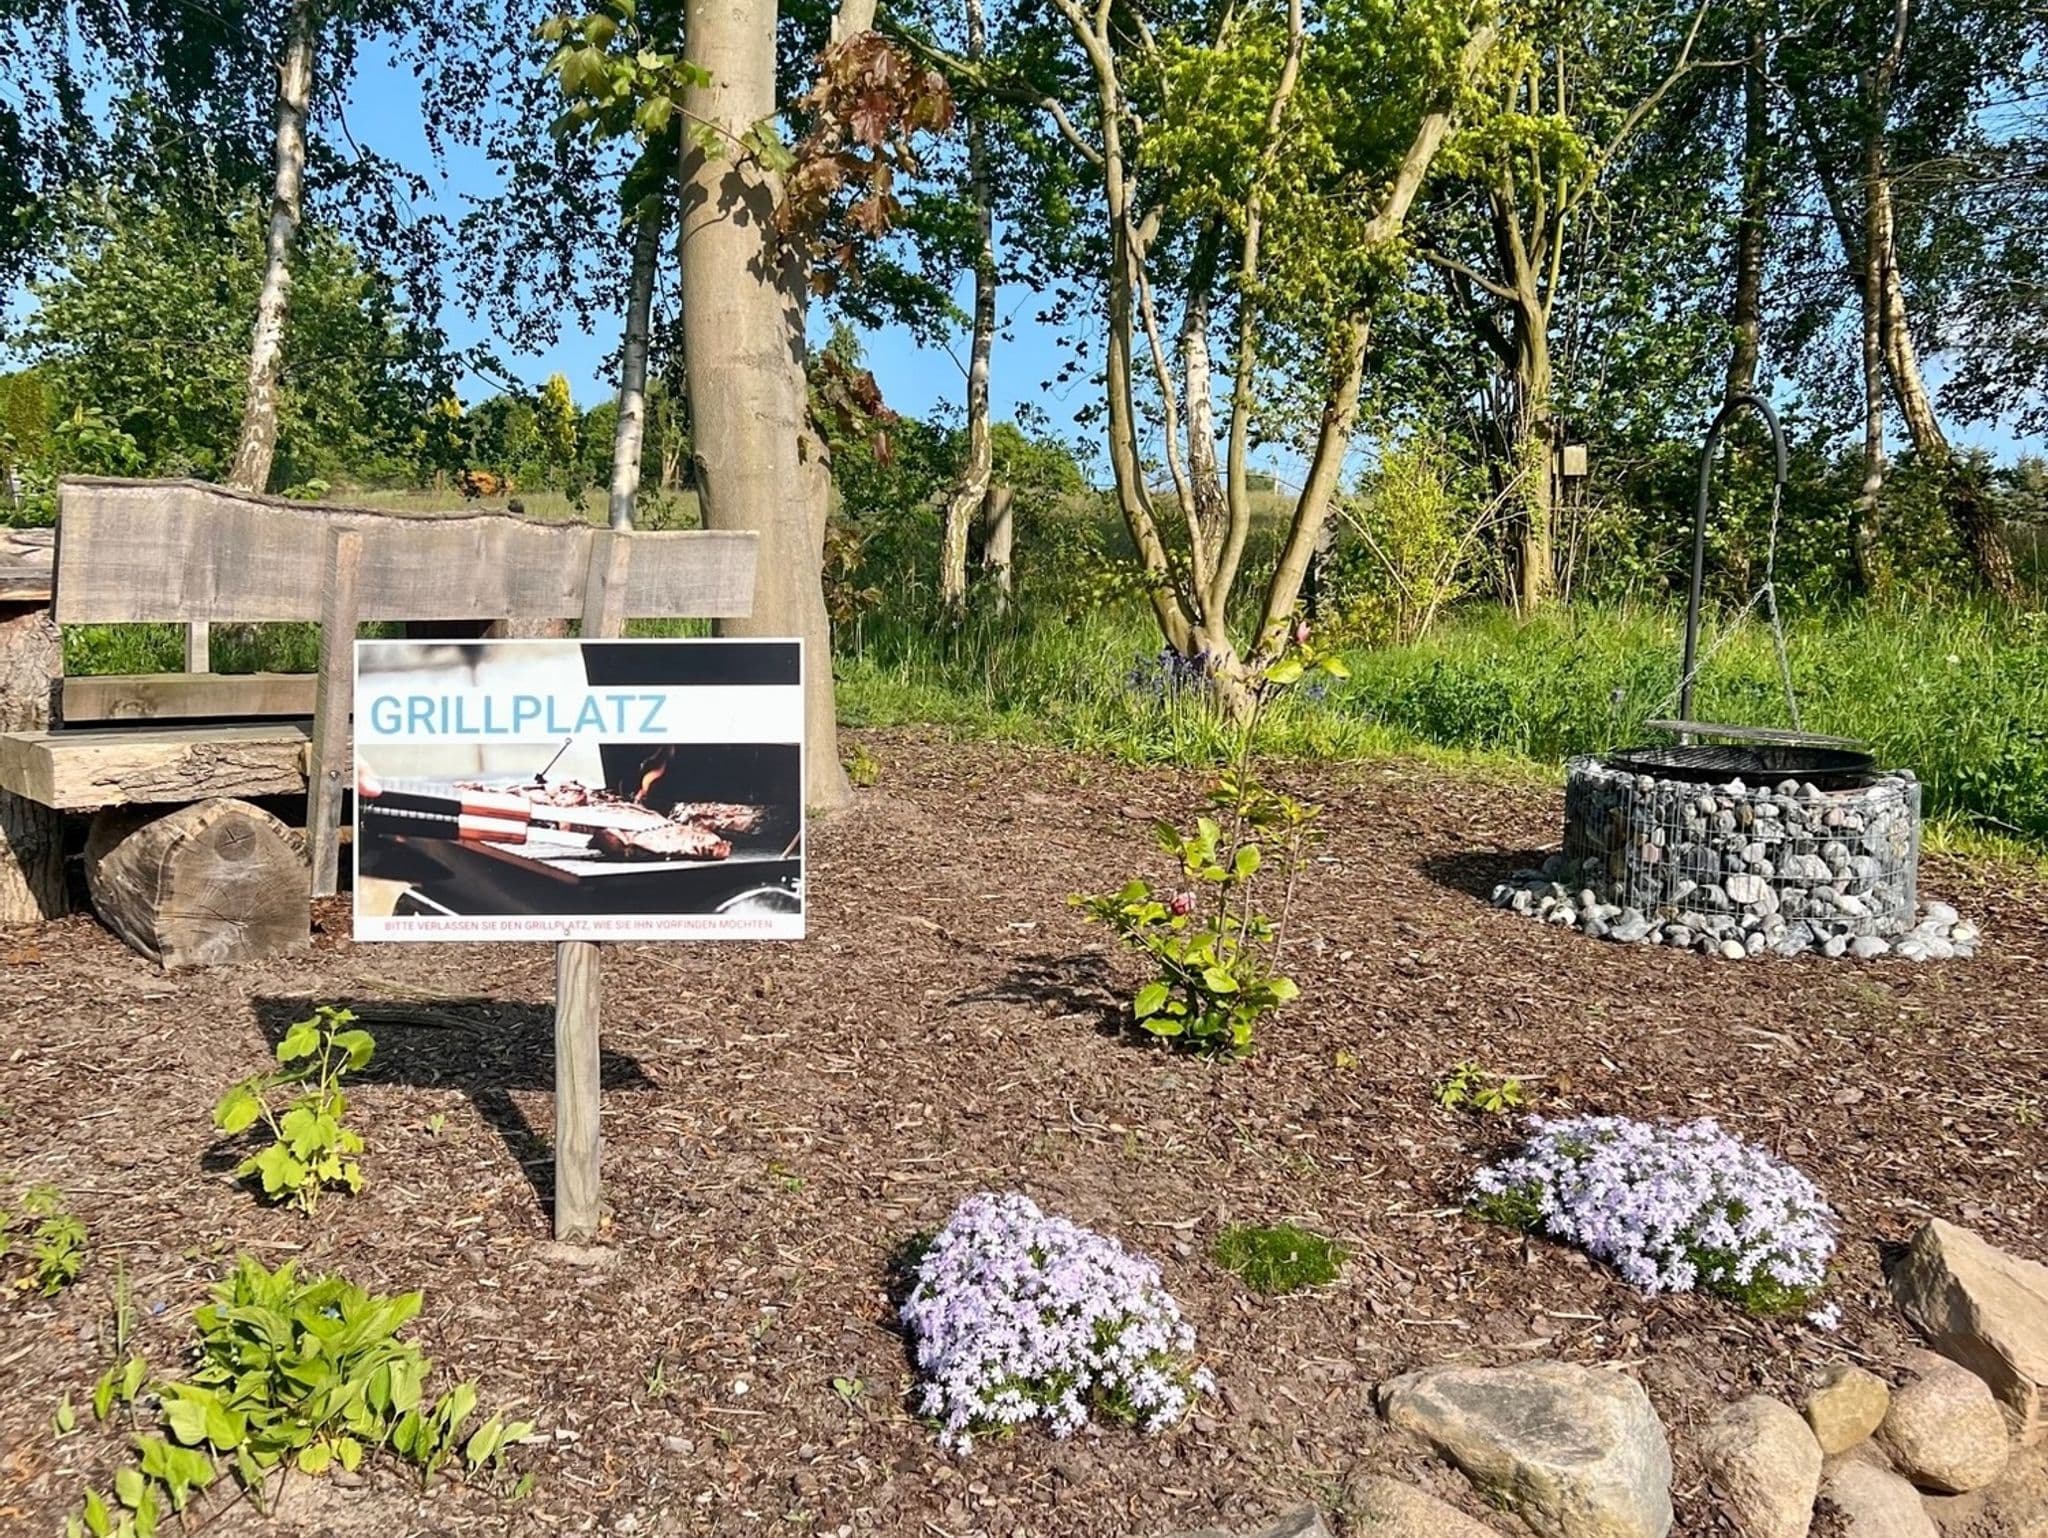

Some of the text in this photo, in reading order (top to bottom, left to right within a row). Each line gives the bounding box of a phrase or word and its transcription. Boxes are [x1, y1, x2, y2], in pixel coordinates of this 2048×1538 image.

[371, 694, 668, 735] GRILLPLATZ
[384, 920, 414, 931] BITTE
[418, 920, 479, 931] VERLASSEN
[482, 920, 497, 931] SIE
[500, 920, 522, 931] DEN
[593, 919, 613, 930] WIE
[615, 919, 631, 930] SIE
[633, 919, 653, 930] IHN
[656, 919, 716, 930] VORFINDEN
